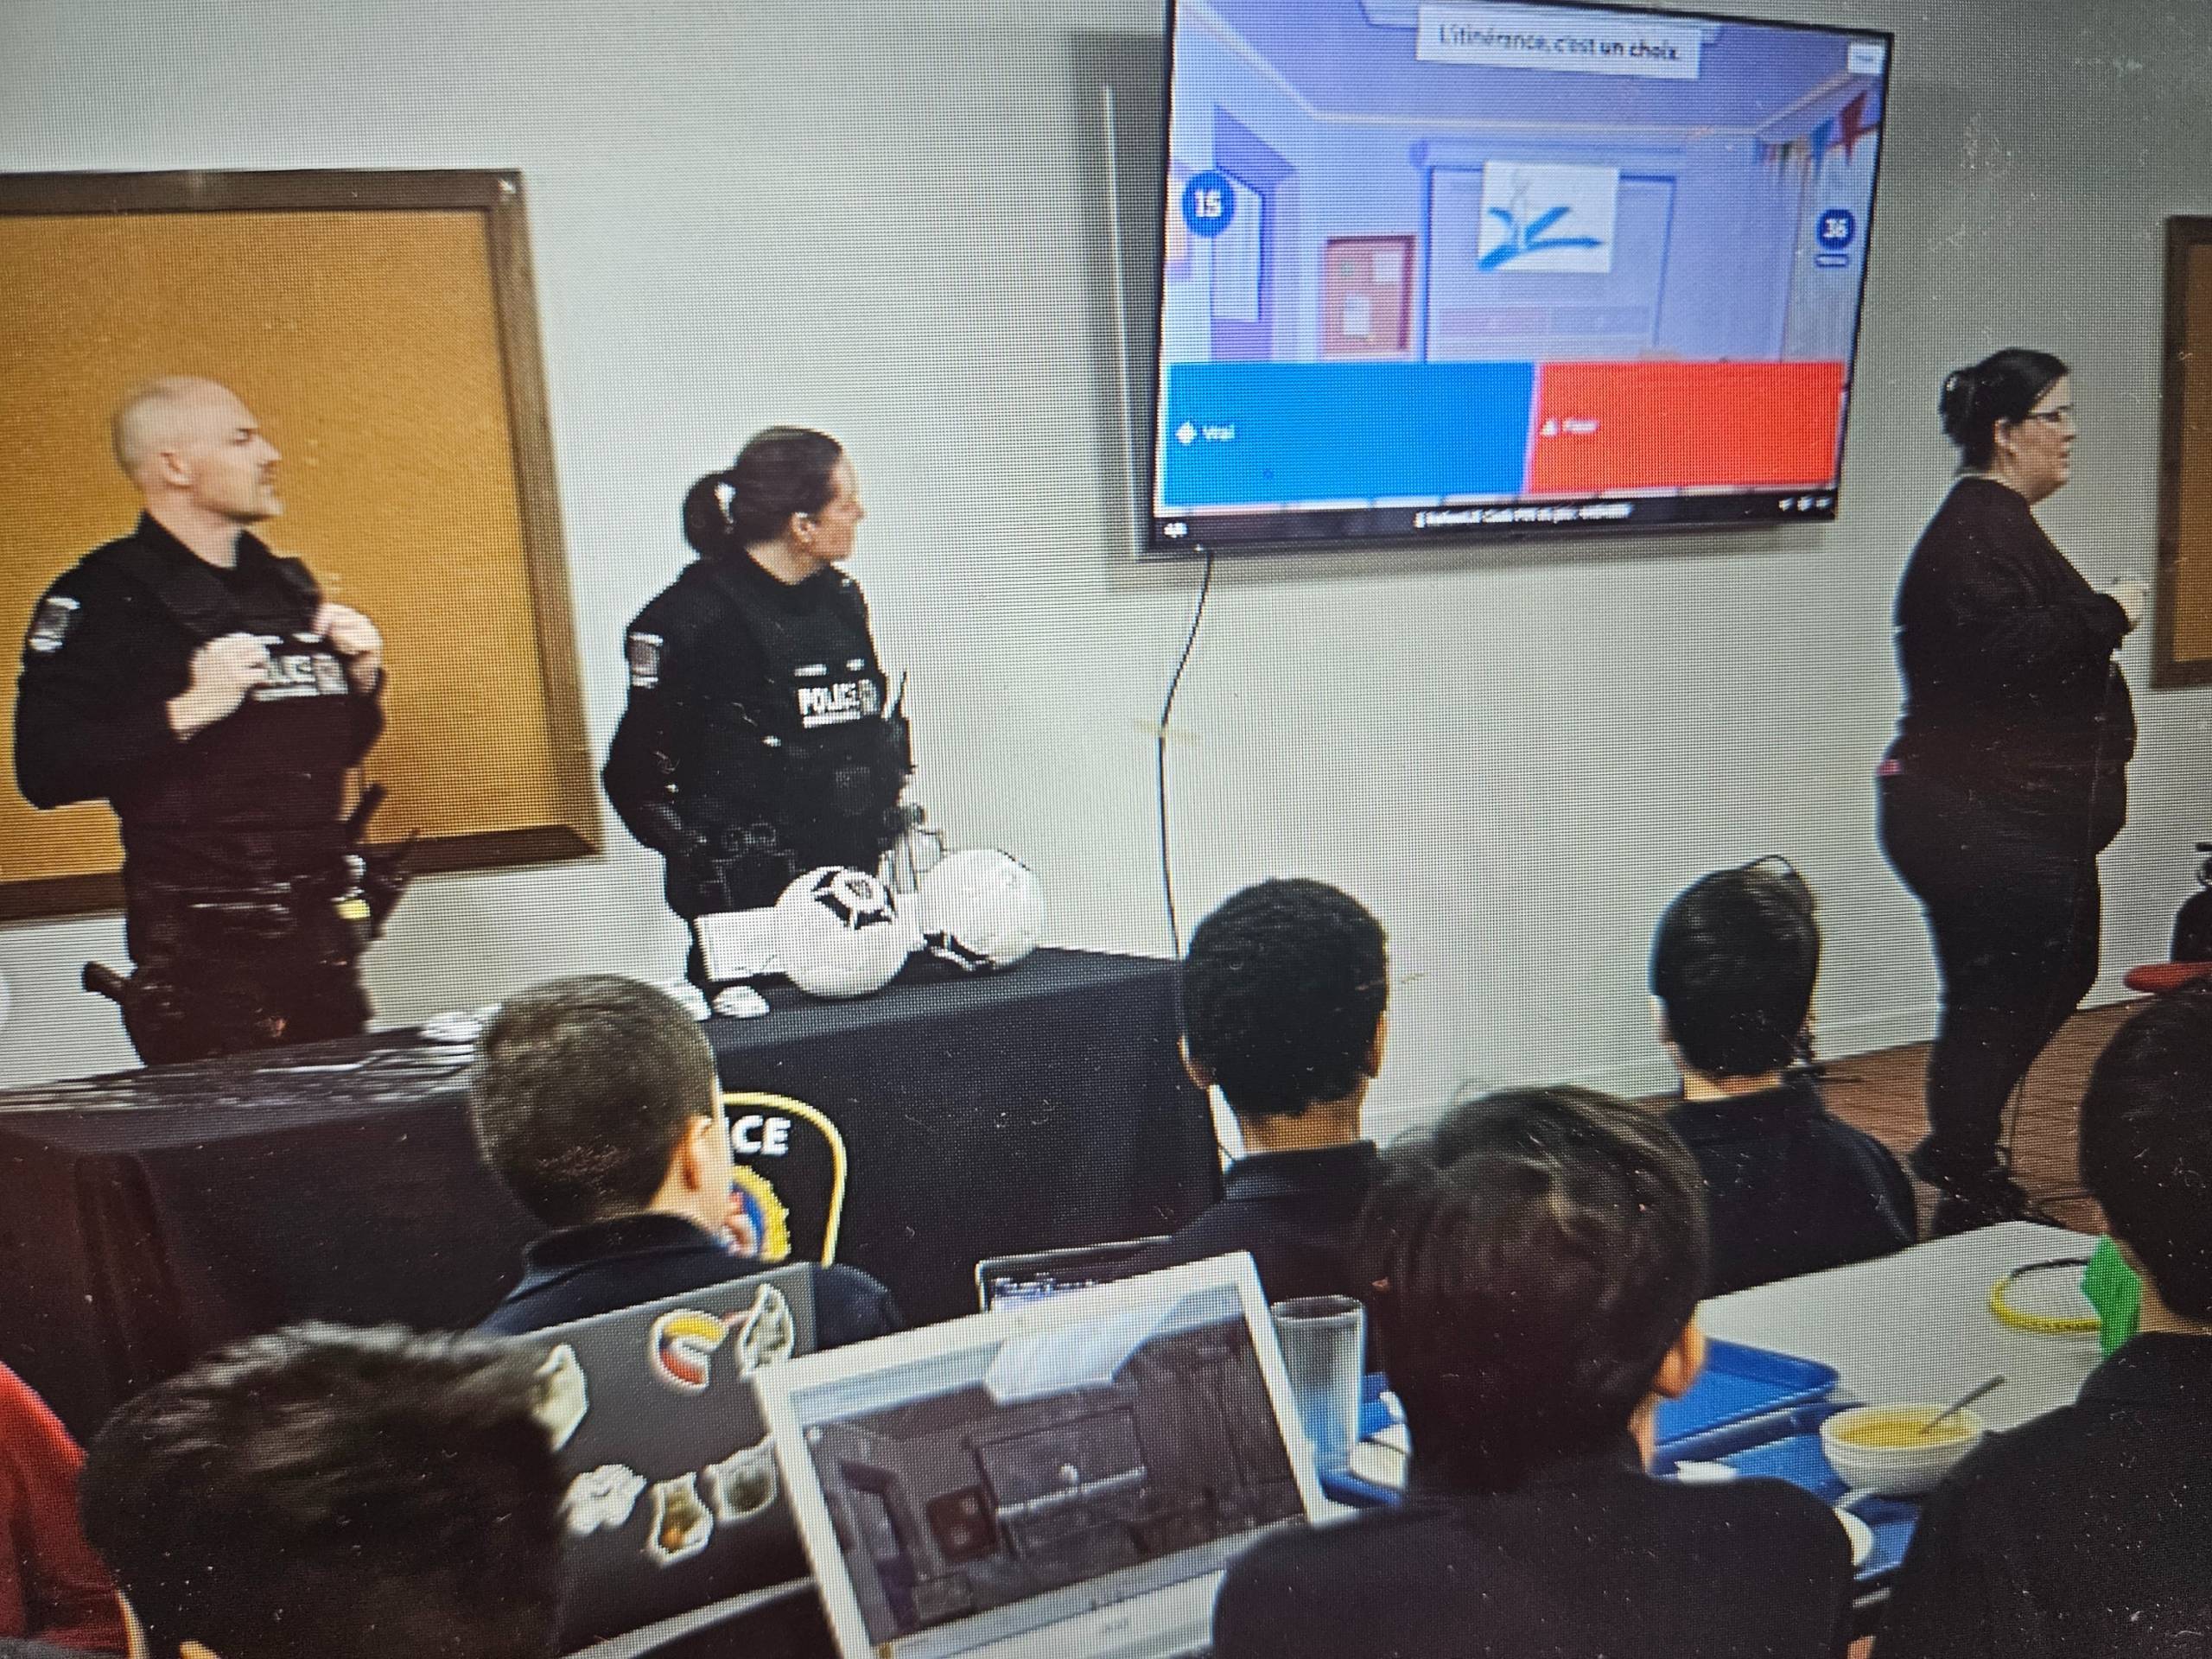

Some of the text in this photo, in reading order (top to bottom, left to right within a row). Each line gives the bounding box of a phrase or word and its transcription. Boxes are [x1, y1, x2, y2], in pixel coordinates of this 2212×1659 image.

[1554, 35, 1596, 54] c'est
[1600, 41, 1624, 56] un
[1629, 38, 1681, 61] choix.
[1194, 189, 1223, 218] 15
[798, 683, 860, 716] POLICE
[731, 1114, 791, 1155] CE
